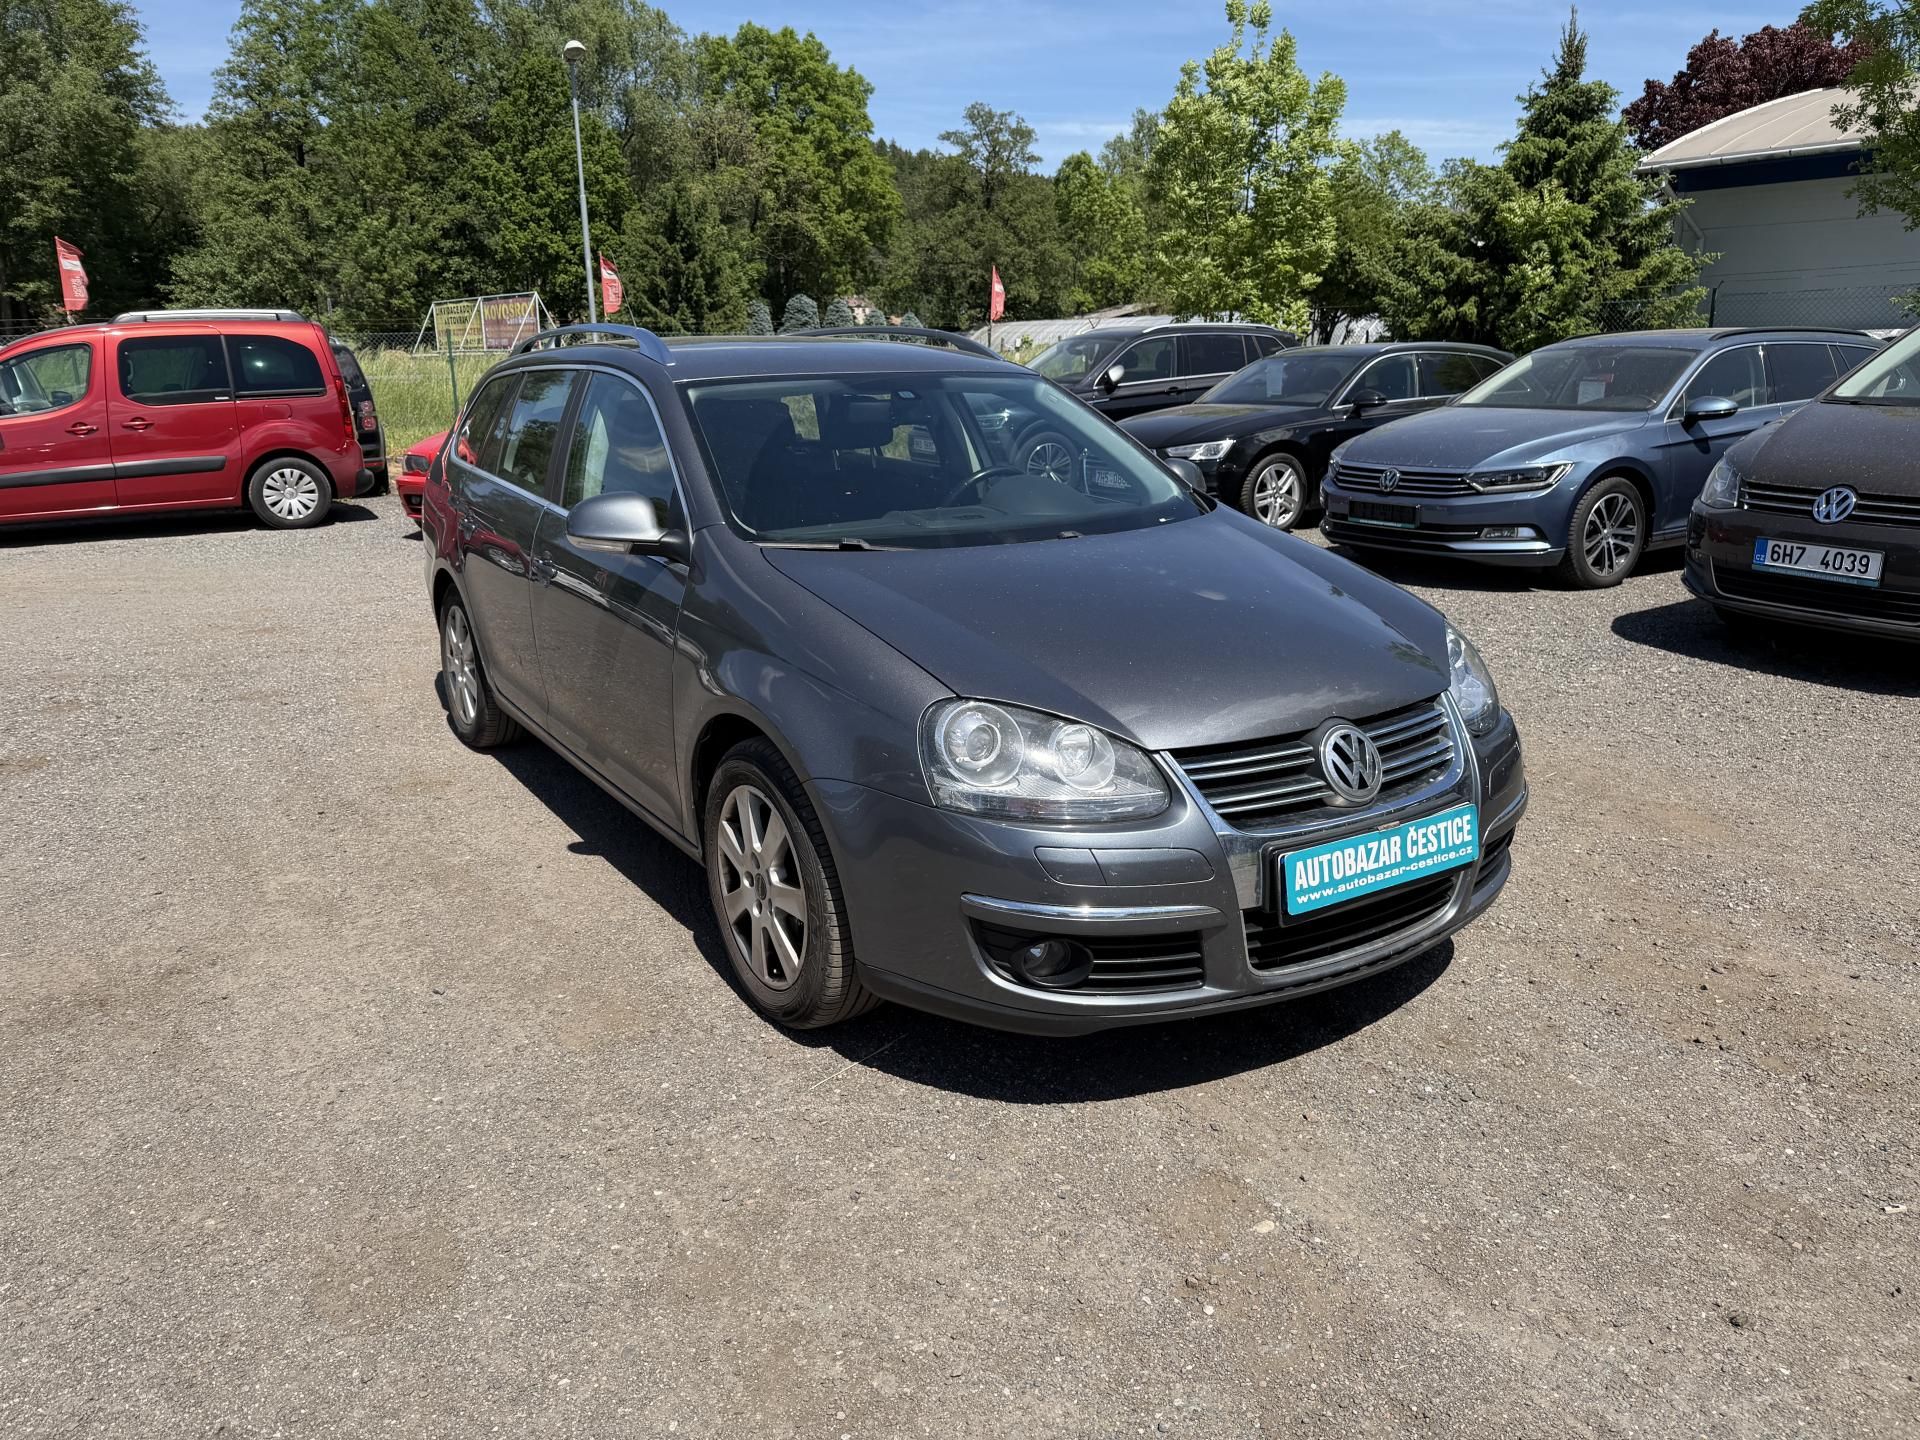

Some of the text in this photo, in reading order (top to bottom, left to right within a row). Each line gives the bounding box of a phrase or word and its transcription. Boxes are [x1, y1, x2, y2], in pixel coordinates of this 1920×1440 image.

[1770, 543, 1871, 574] 6H7 4039
[1295, 814, 1473, 891] AUTOBAZAR ČESTICE
[1296, 845, 1473, 904] www.autobazar-cestice.cz
